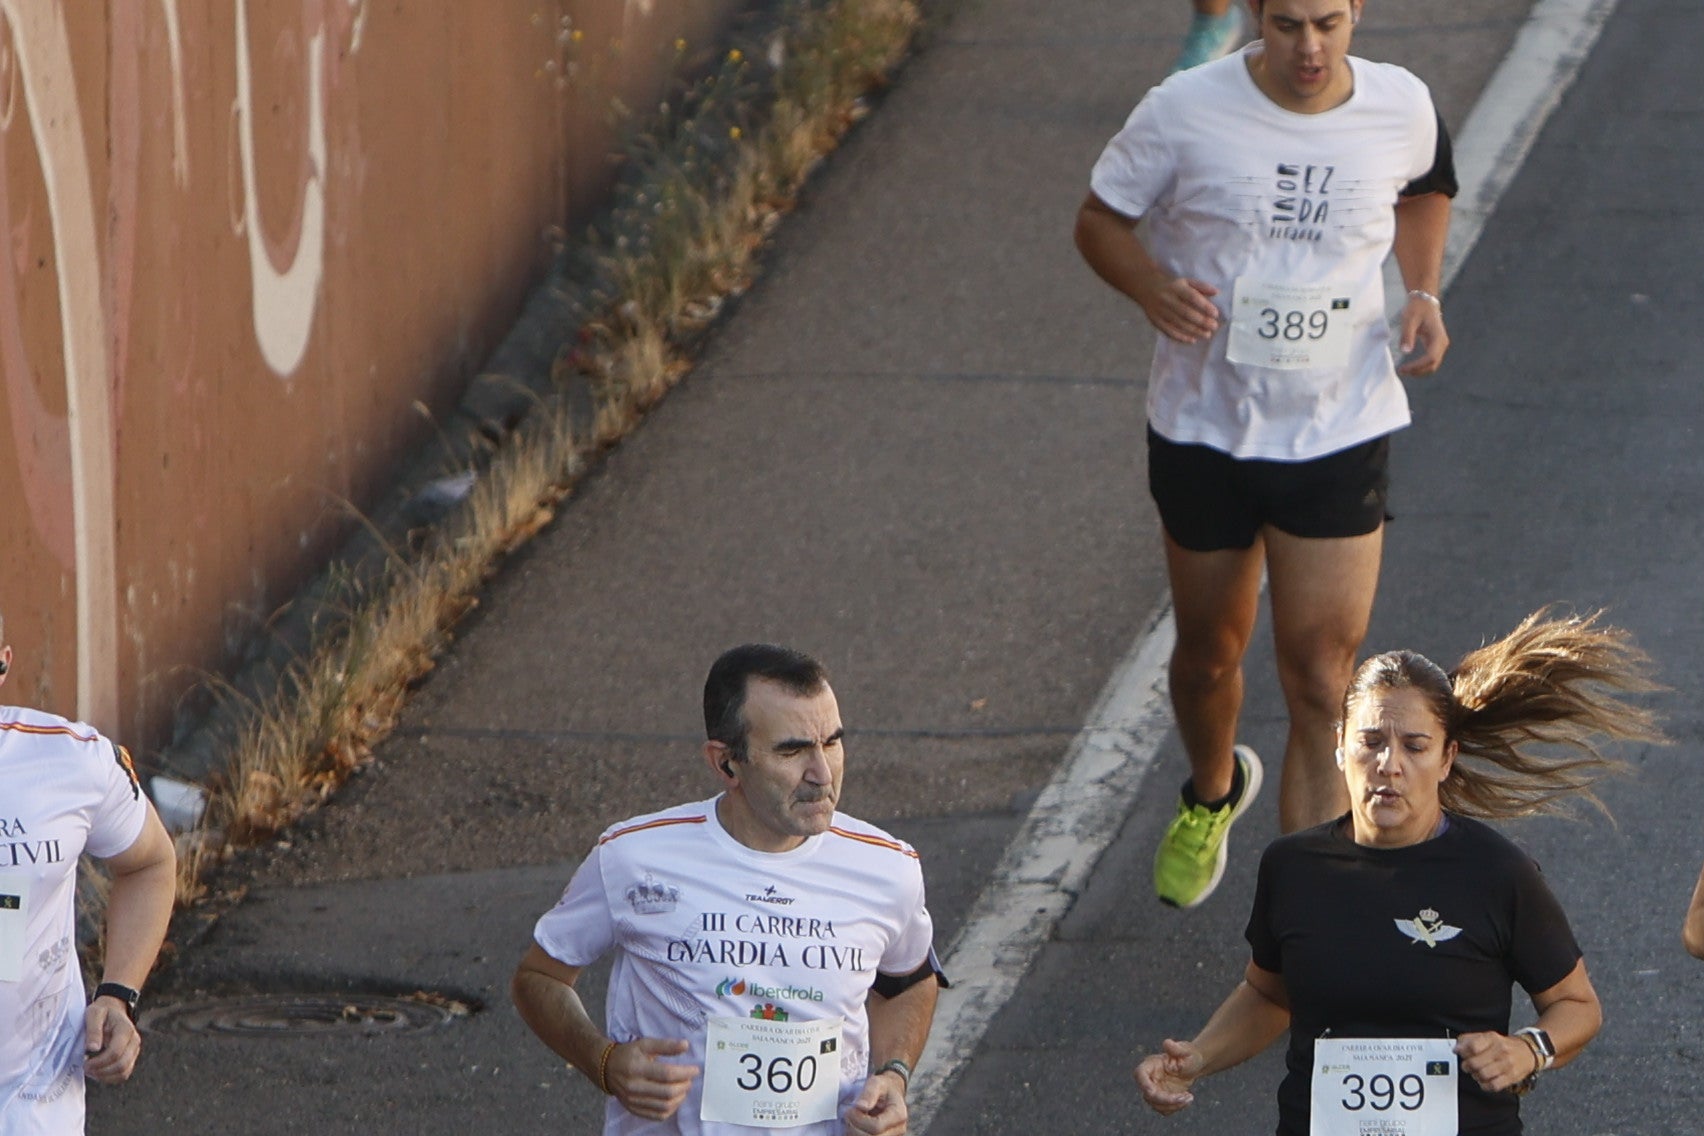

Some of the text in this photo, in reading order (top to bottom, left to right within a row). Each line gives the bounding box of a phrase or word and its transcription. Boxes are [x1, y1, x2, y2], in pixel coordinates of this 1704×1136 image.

[1258, 308, 1328, 341] 389
[702, 912, 836, 939] III CARRERA
[667, 939, 866, 972] GVARDIA CIVIL
[749, 981, 824, 1002] Iberdrola
[736, 1053, 817, 1093] 360
[1341, 1074, 1425, 1111] 399
